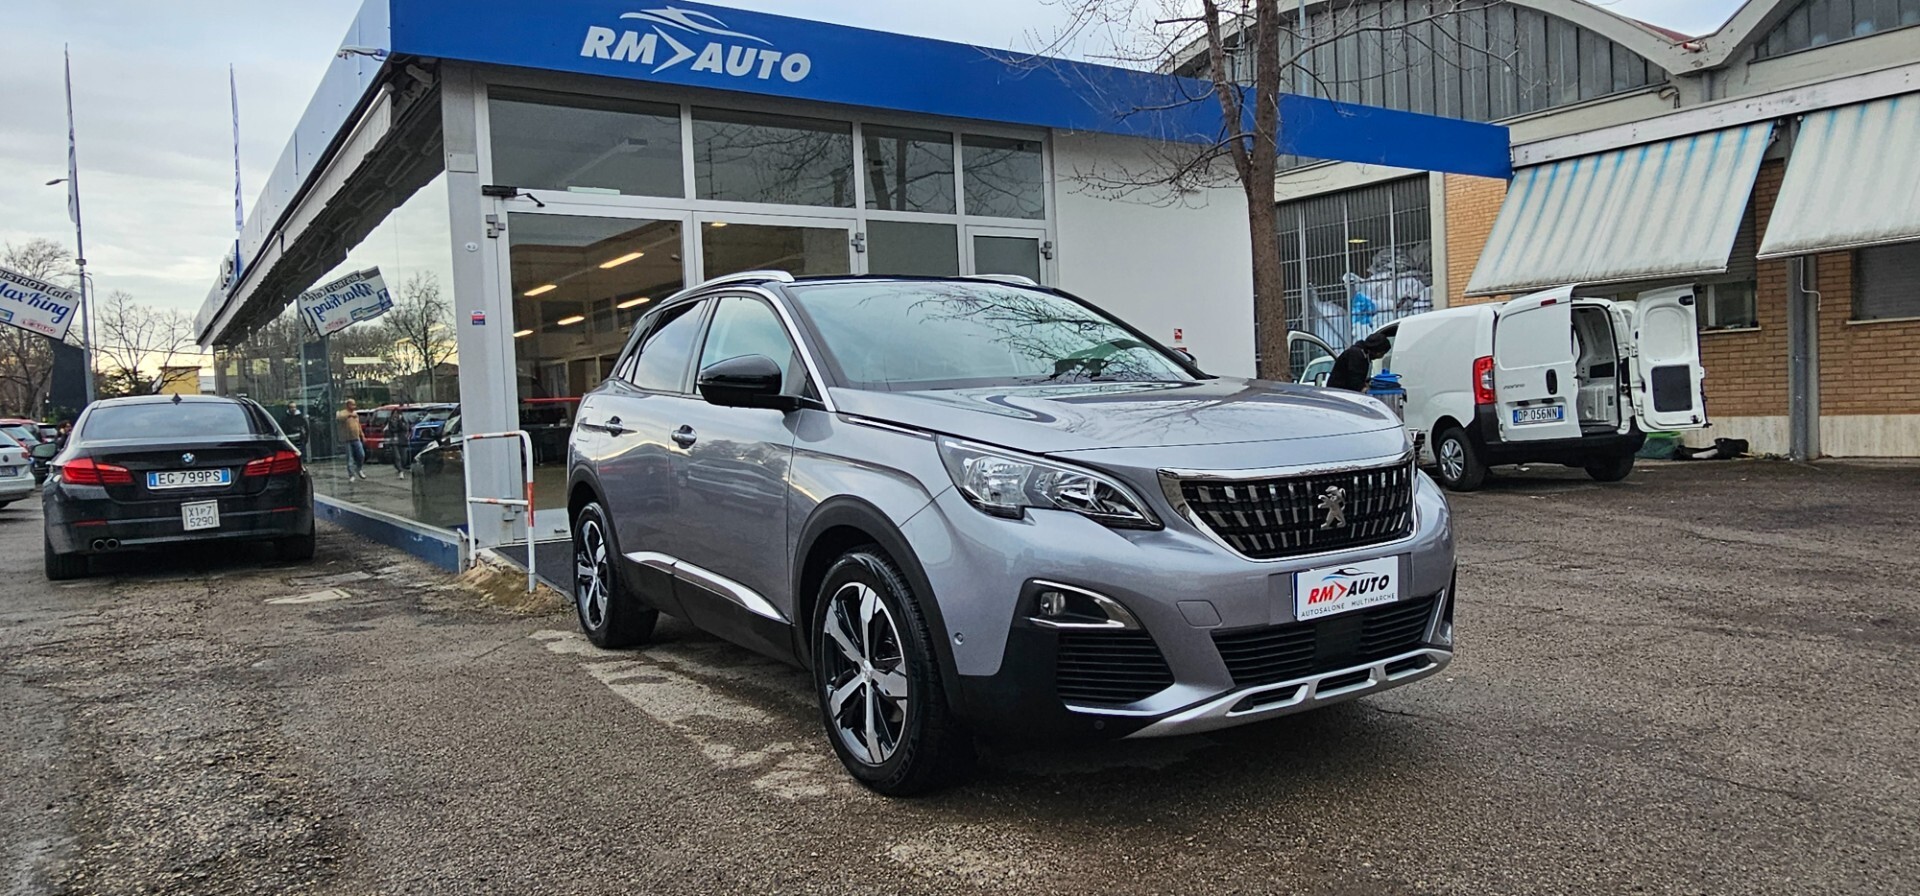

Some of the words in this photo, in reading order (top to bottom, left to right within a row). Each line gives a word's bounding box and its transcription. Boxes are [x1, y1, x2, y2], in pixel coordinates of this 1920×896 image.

[580, 25, 658, 65] RM
[690, 42, 812, 83] AUTO
[1518, 410, 1529, 421] DP
[1530, 407, 1558, 420] 056NN
[158, 473, 175, 485] EG
[180, 470, 221, 483] 799PS
[189, 516, 214, 528] 5290
[1307, 585, 1335, 605] RM
[1346, 575, 1390, 598] AUTO
[1301, 603, 1345, 617] AUTOSALONE
[1351, 593, 1396, 606] MULTIMARCHE
